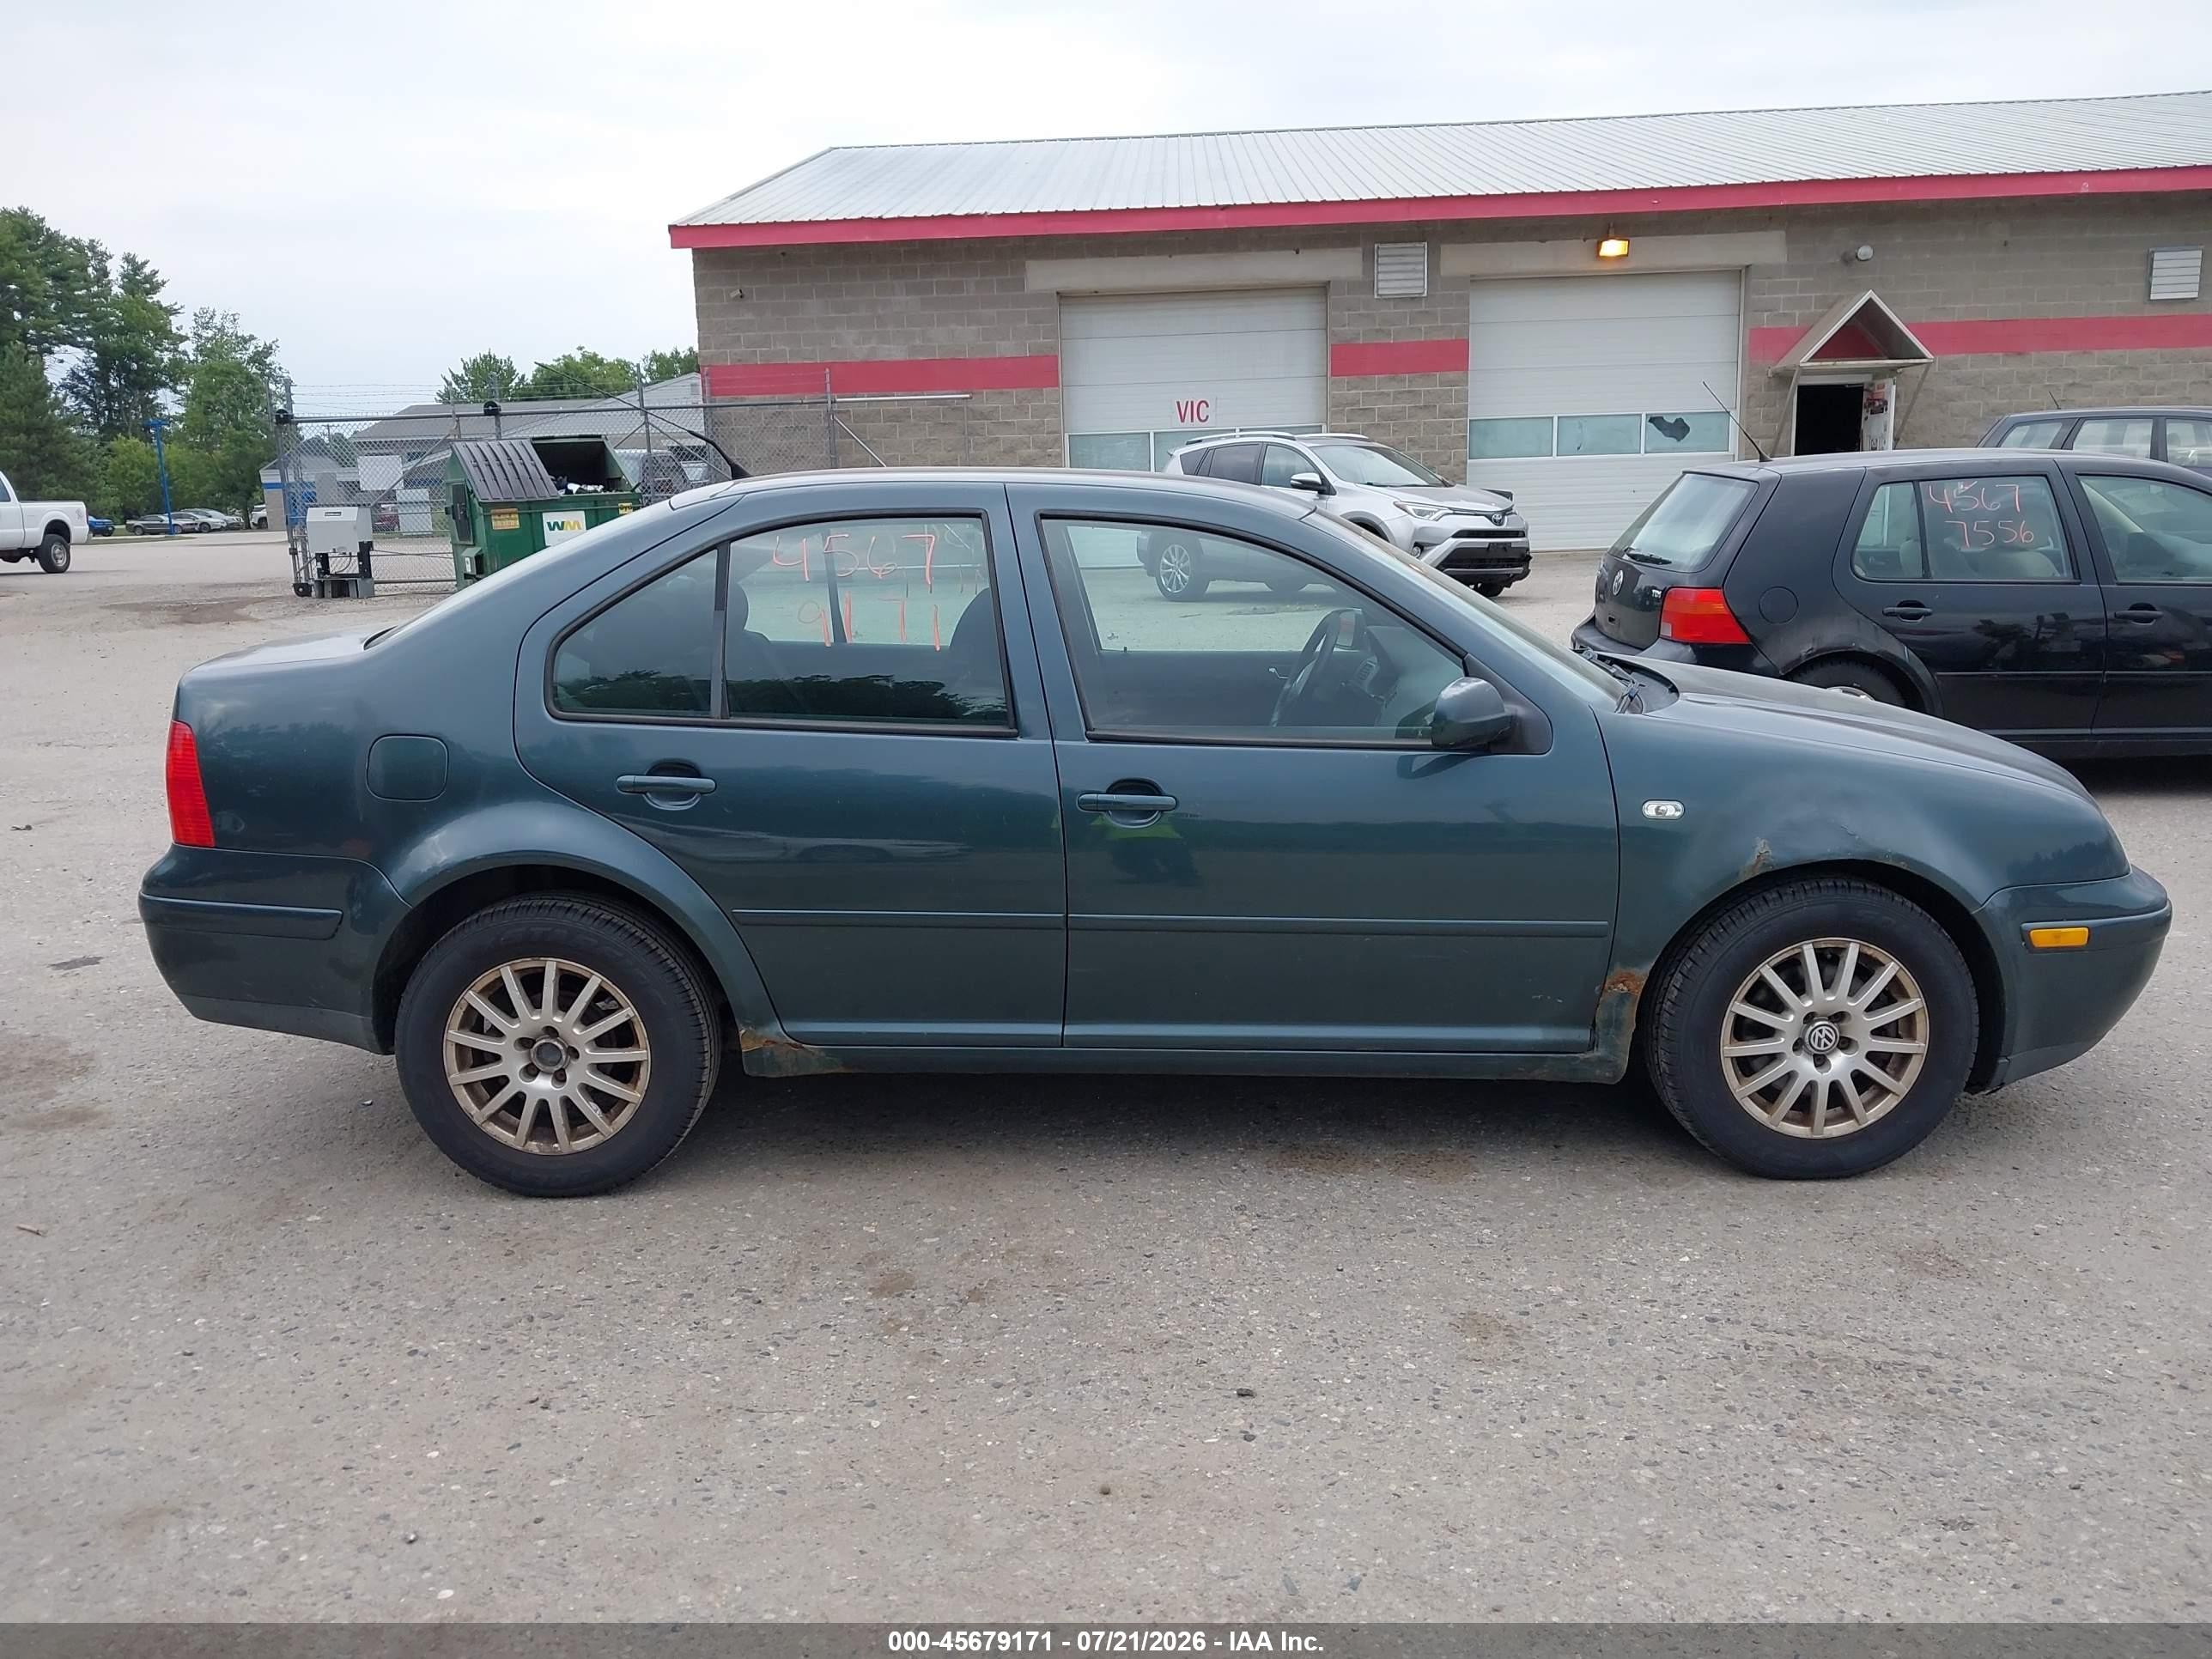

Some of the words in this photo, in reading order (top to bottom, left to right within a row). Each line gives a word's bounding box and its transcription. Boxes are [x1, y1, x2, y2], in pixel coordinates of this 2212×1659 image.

[1176, 399, 1210, 423] VIC
[1929, 480, 2021, 514] 4567
[546, 520, 582, 532] WM
[1943, 520, 2034, 548] 7556
[773, 534, 935, 585] 4567
[797, 591, 941, 652] 9171
